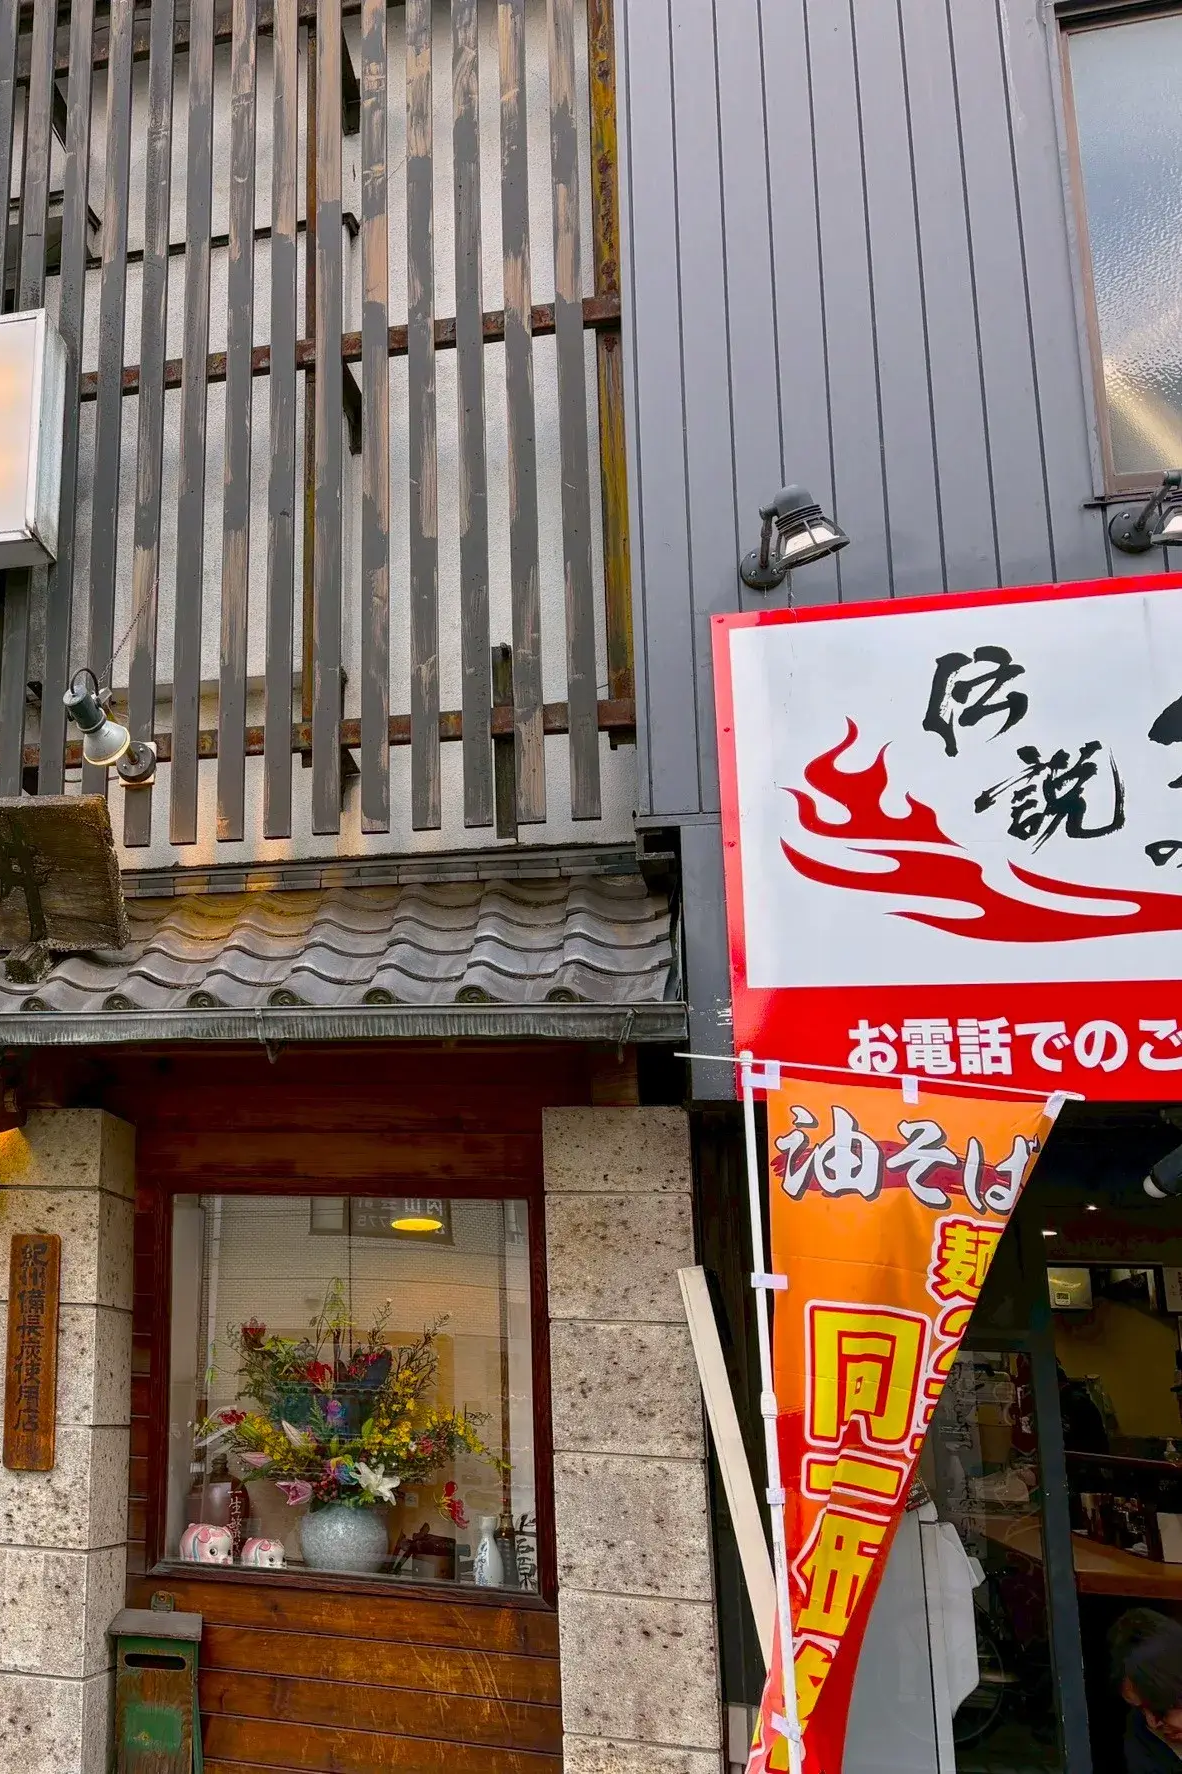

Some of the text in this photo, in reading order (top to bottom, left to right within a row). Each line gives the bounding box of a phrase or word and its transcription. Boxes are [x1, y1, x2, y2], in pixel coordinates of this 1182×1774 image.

[847, 1016, 1182, 1076] お電話でのご
[775, 1105, 1039, 1214] 油そば
